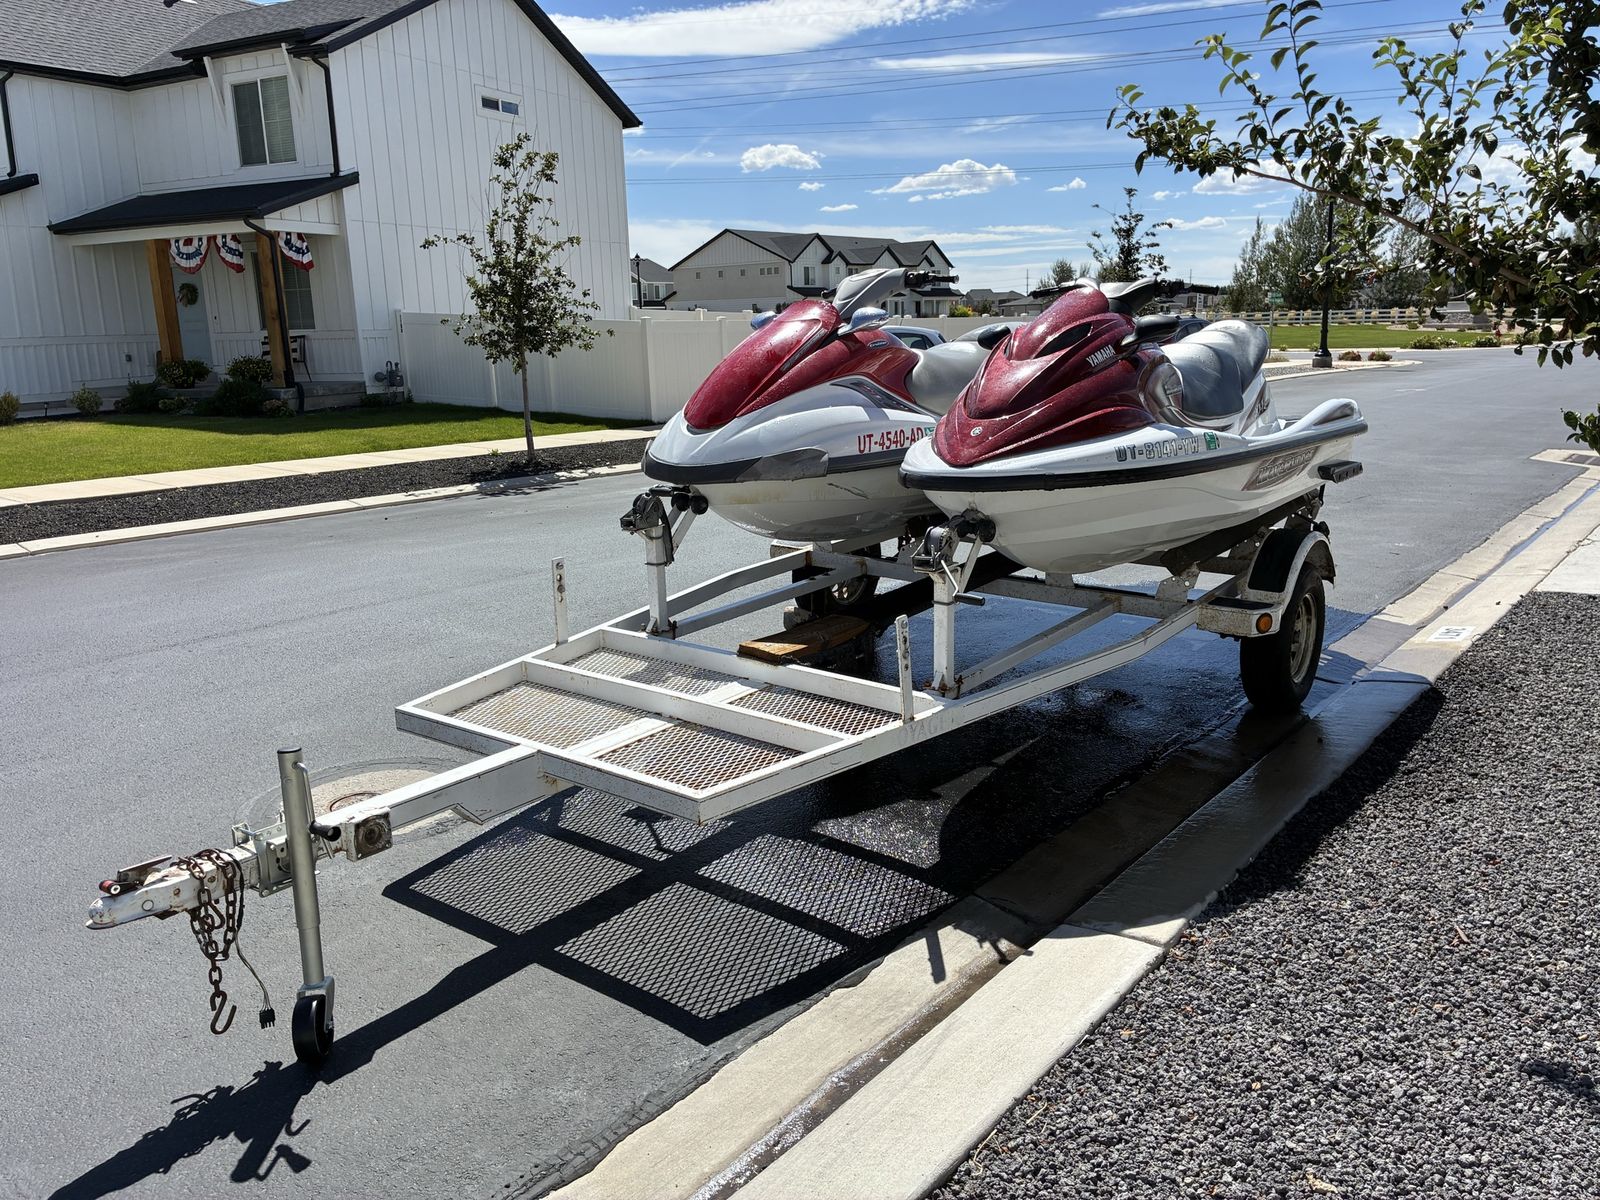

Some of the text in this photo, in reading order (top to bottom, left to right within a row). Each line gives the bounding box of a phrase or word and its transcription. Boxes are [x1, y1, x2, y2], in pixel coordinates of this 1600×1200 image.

[1086, 344, 1116, 367] YAMAHA
[857, 426, 924, 454] UT-4540-AD
[1114, 436, 1200, 463] UT-8141-YW
